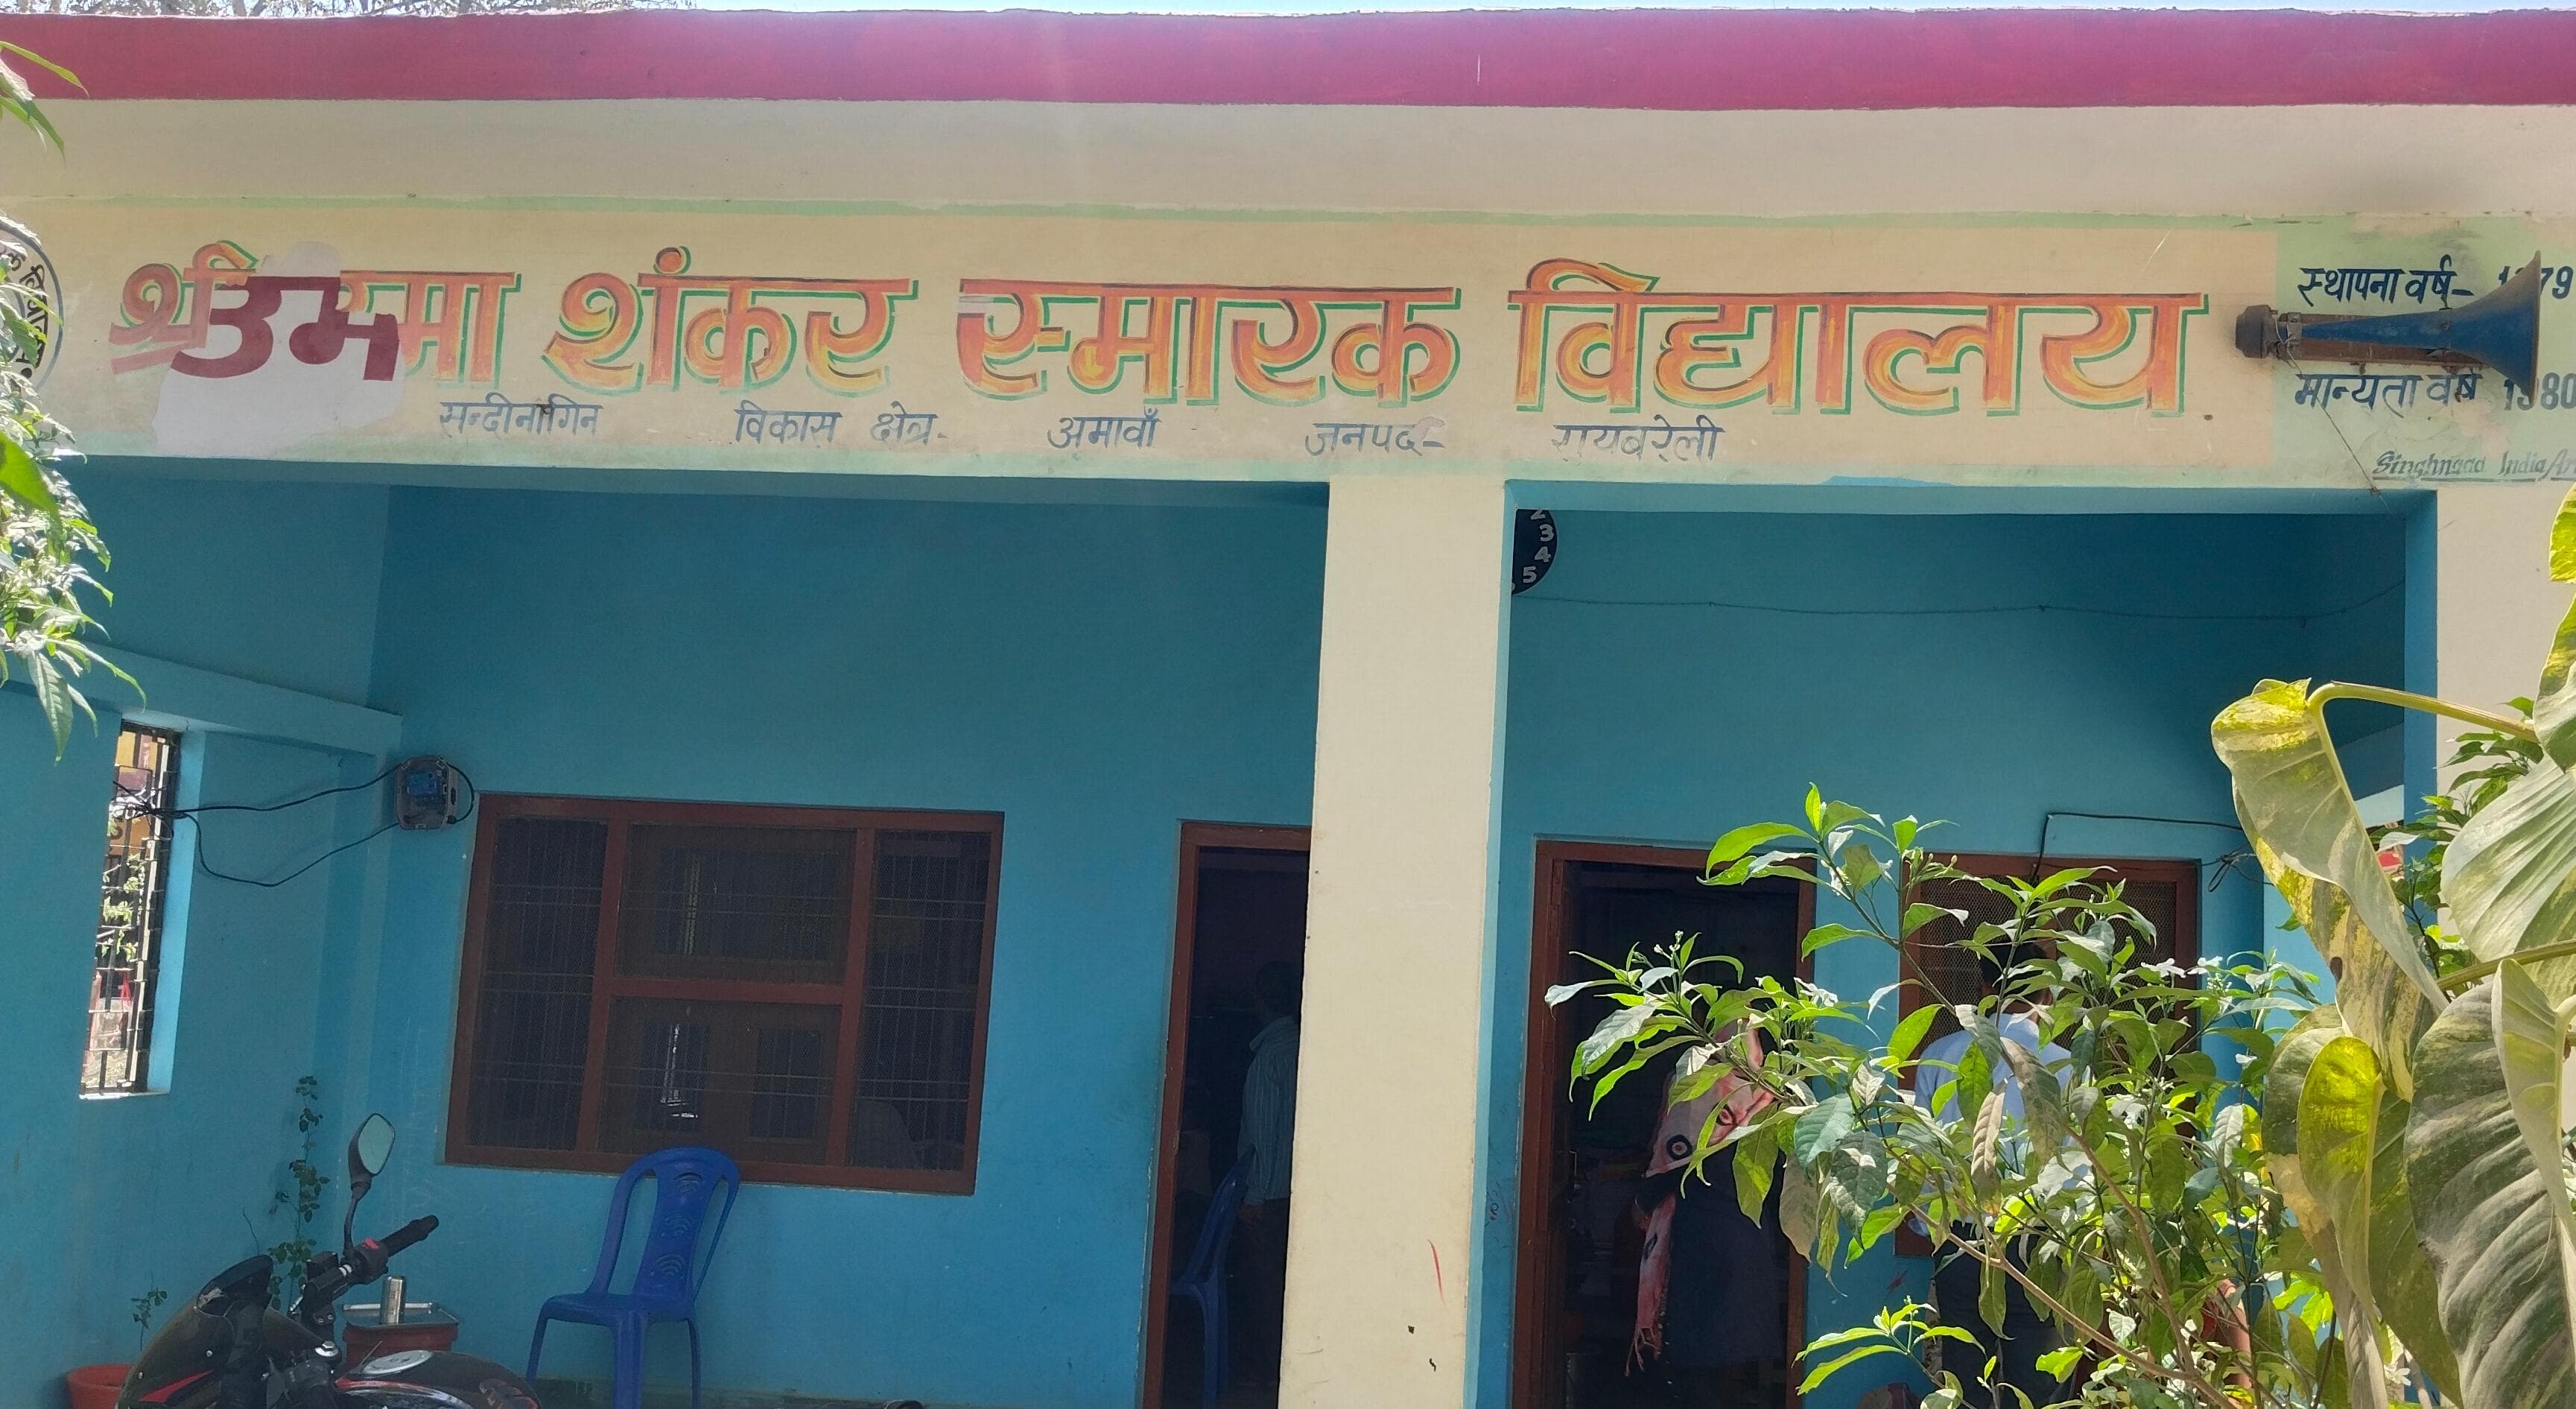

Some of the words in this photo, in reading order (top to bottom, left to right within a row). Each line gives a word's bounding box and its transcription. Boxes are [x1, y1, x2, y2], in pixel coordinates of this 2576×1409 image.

[2297, 267, 2406, 307] स्थापना
[2499, 266, 2574, 299] 179
[542, 246, 919, 397] शंकर
[957, 279, 1462, 407] स्मारक
[1508, 259, 2209, 417] विद्यालय
[2294, 374, 2423, 418] मान्यता
[733, 399, 843, 445] विकास
[2498, 450, 2548, 477] India
[1540, 524, 1555, 542] 3
[1534, 546, 1551, 563] 4
[1523, 566, 1538, 583] 5
